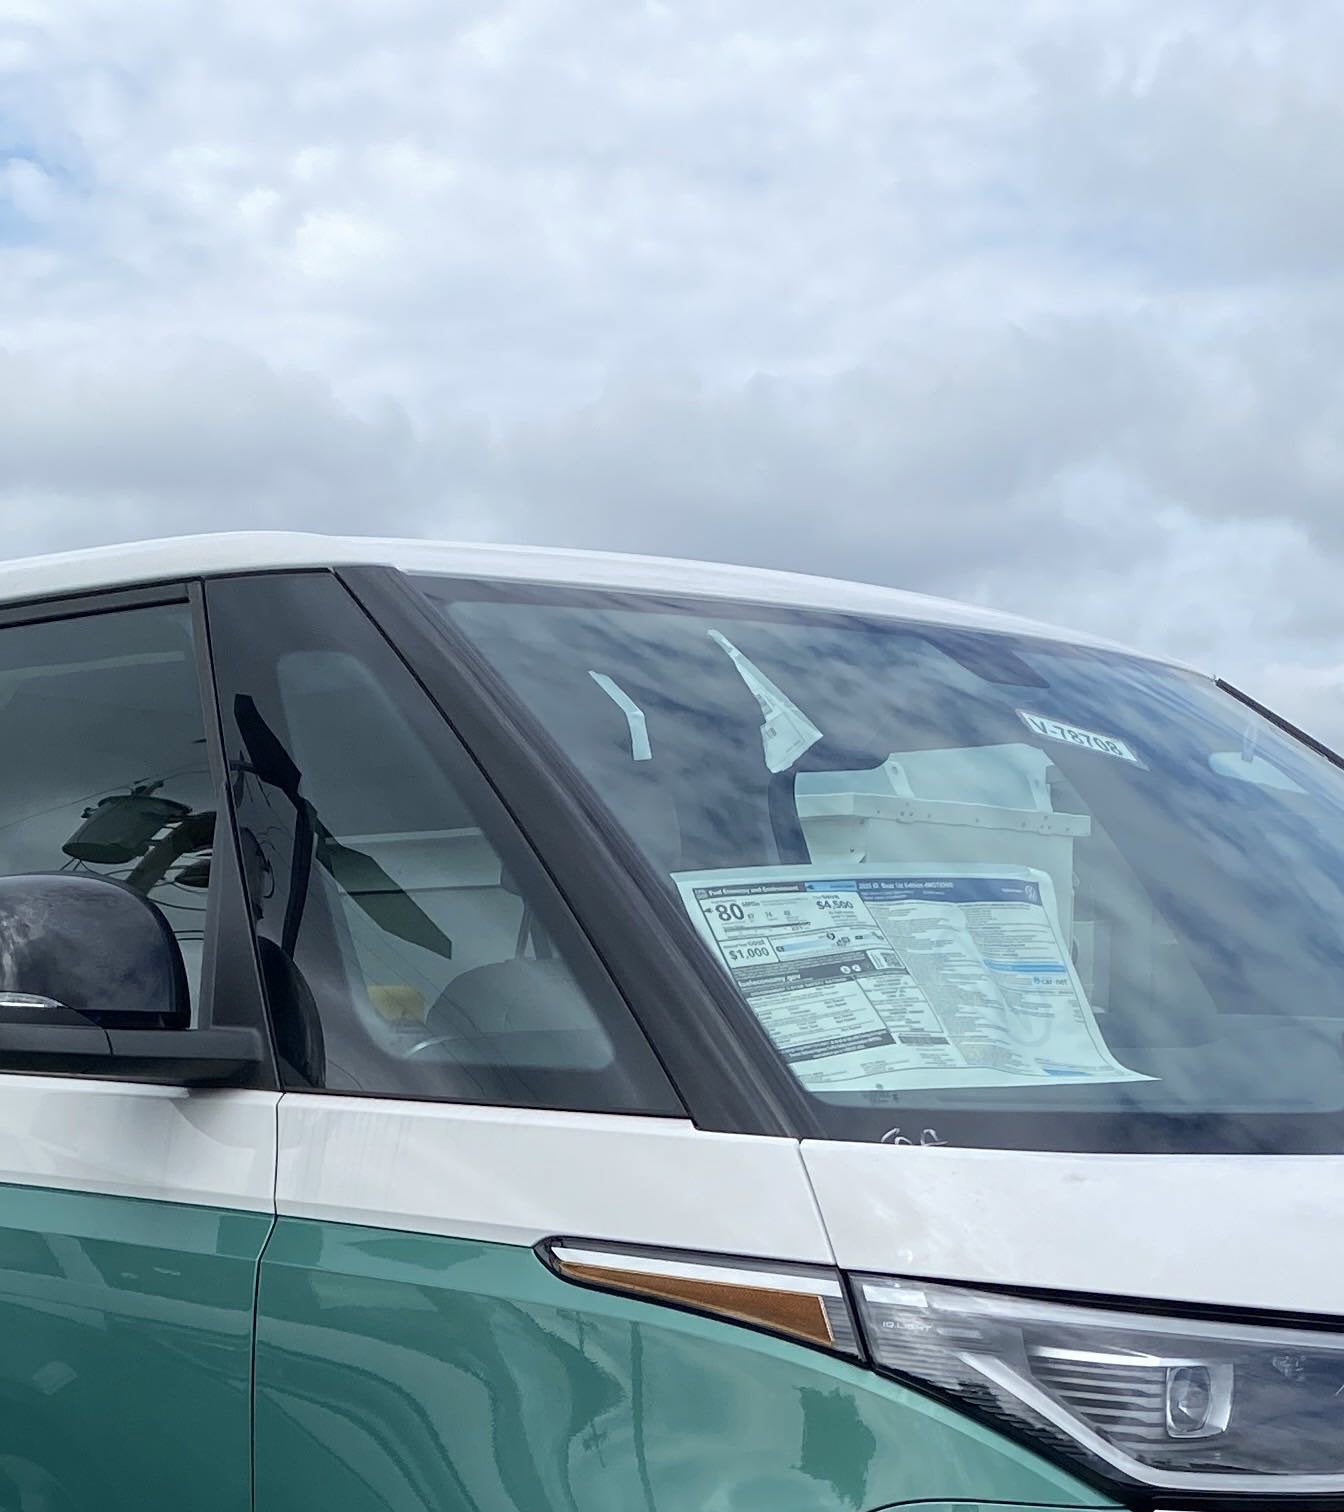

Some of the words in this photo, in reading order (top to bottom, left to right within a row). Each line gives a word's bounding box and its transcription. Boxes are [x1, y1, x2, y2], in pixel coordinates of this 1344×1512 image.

[1027, 717, 1124, 757] V-78708
[715, 903, 745, 922] 80
[729, 946, 770, 962] $1,000
